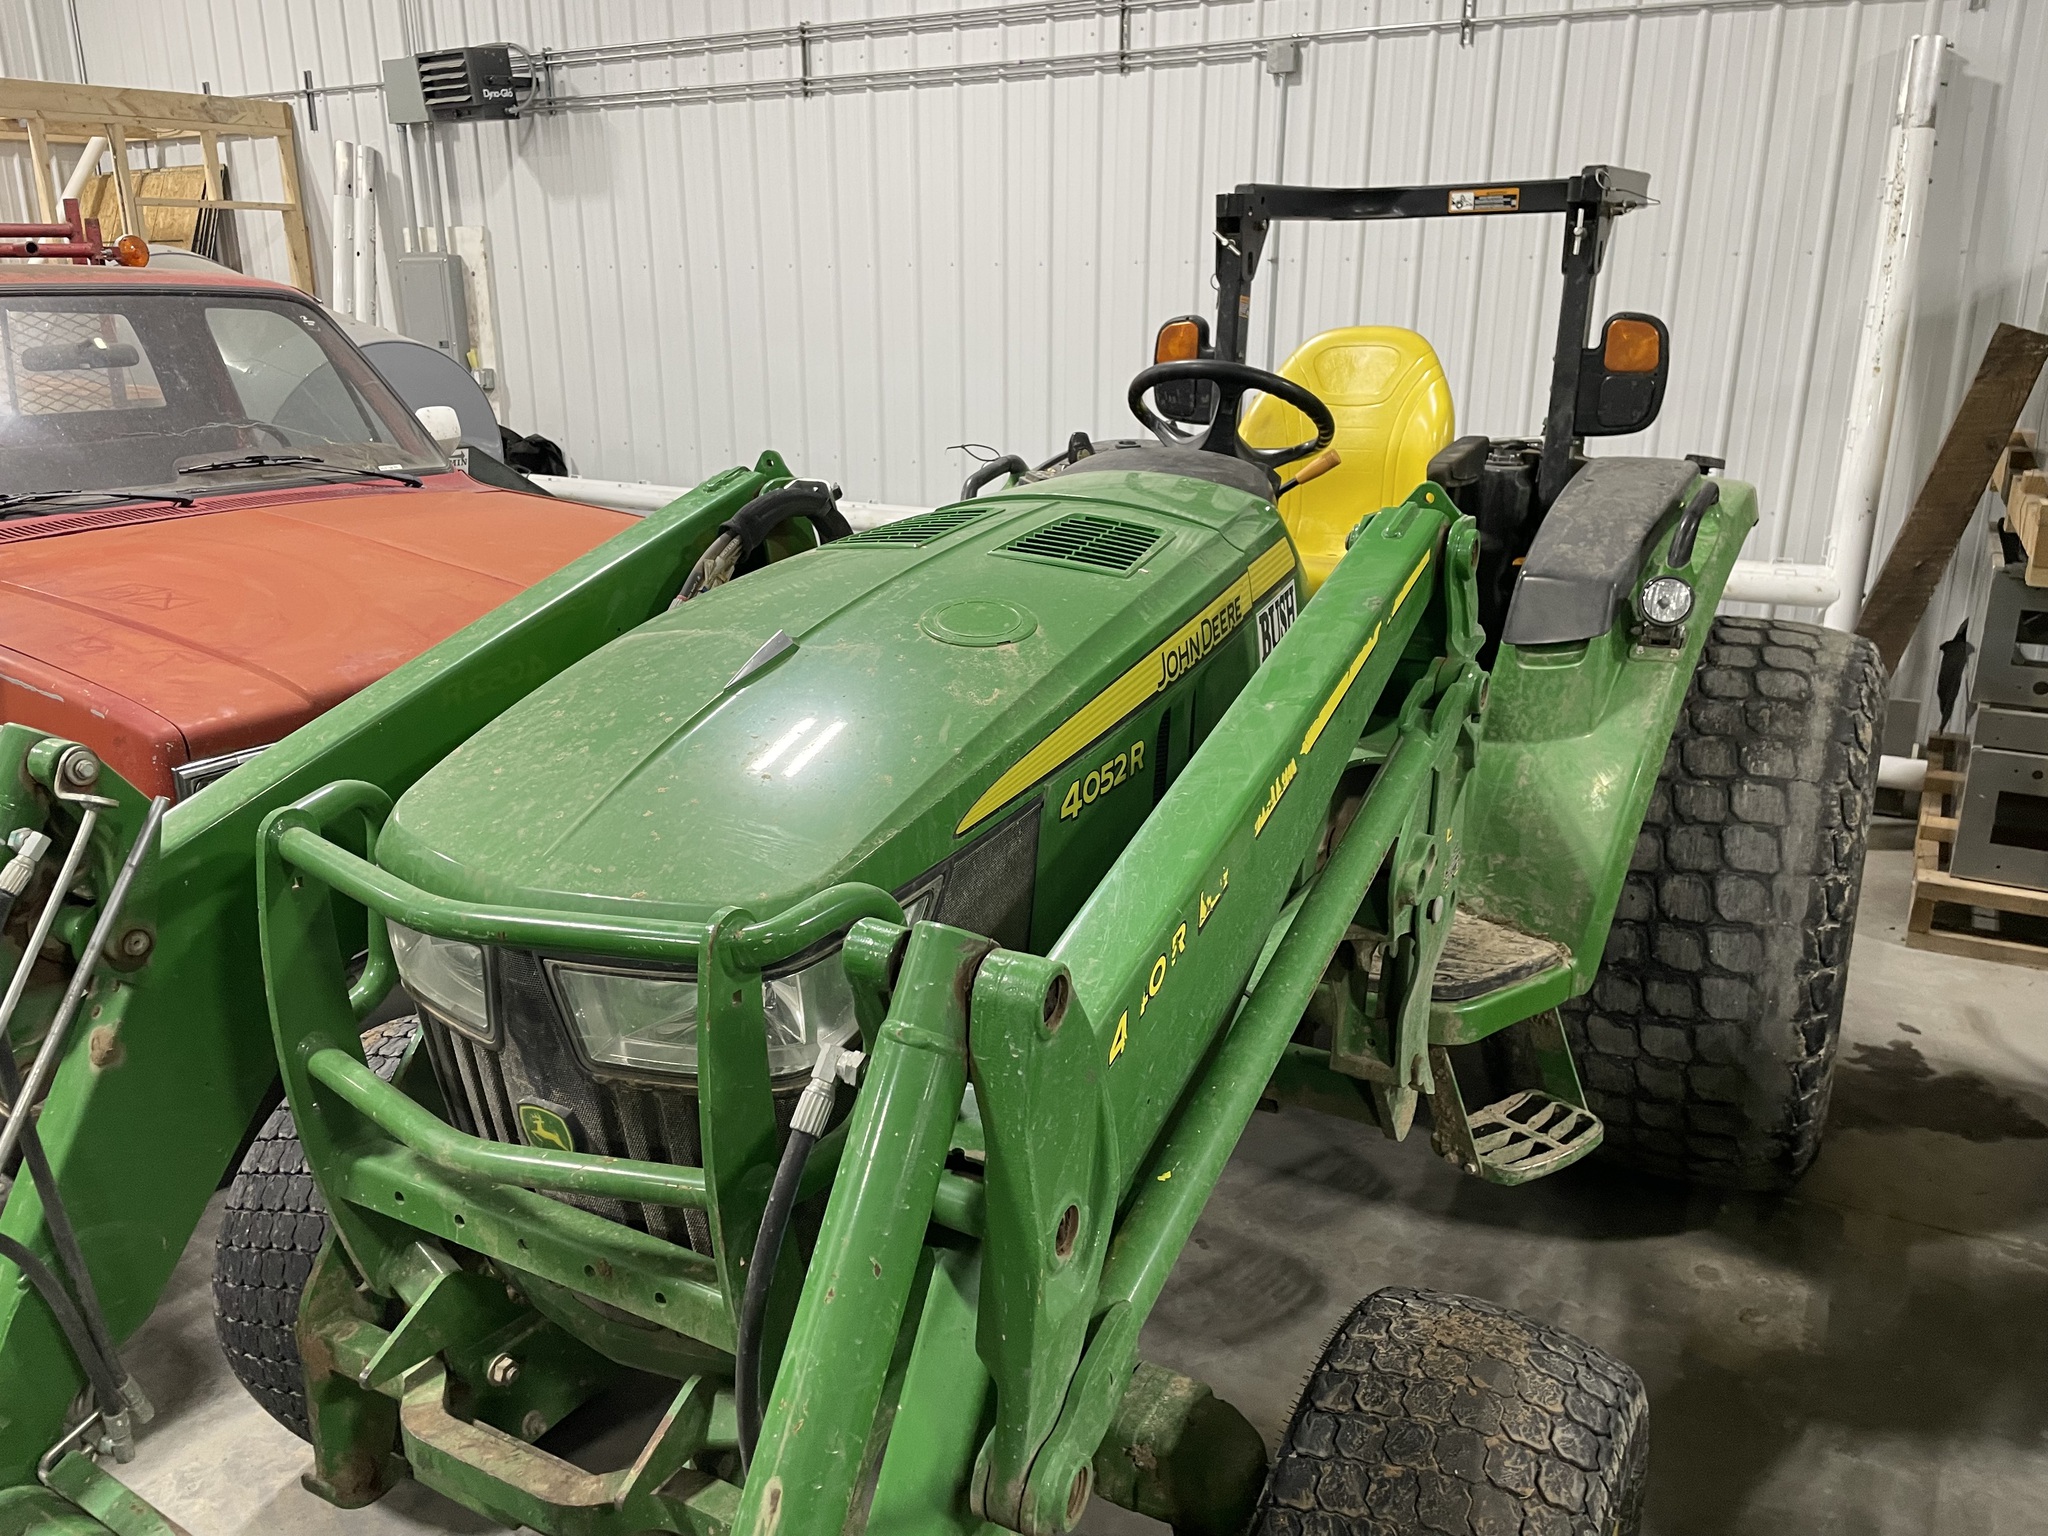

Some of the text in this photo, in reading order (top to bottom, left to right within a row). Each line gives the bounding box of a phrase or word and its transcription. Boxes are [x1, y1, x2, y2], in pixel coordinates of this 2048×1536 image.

[1157, 595, 1243, 689] JOHN DEERE
[1258, 585, 1295, 664] BUSH
[1060, 740, 1146, 820] 4052R
